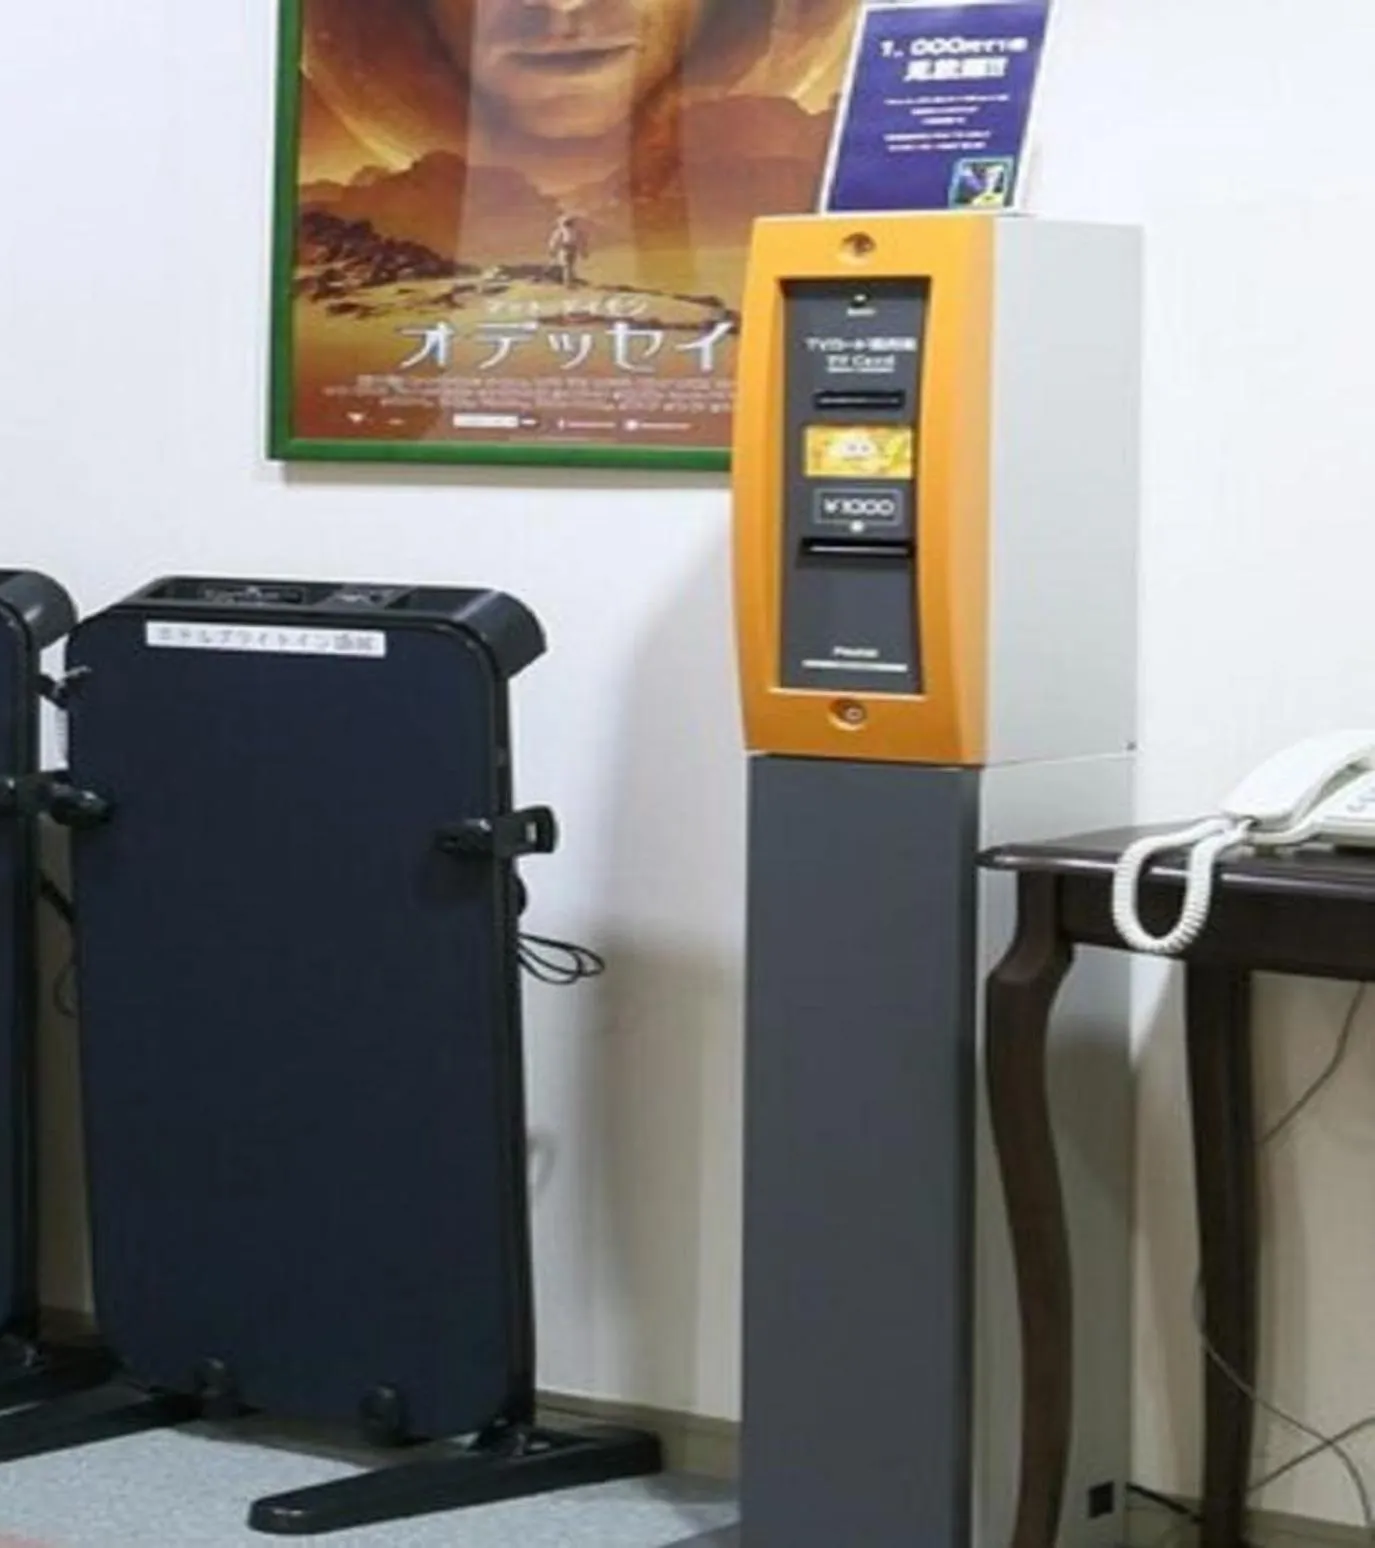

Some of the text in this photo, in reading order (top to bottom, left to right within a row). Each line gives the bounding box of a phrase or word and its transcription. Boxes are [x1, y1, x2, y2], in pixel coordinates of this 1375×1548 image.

[400, 321, 734, 371] オデッセイ
[853, 355, 895, 366] Card
[824, 499, 894, 516] ¥1000
